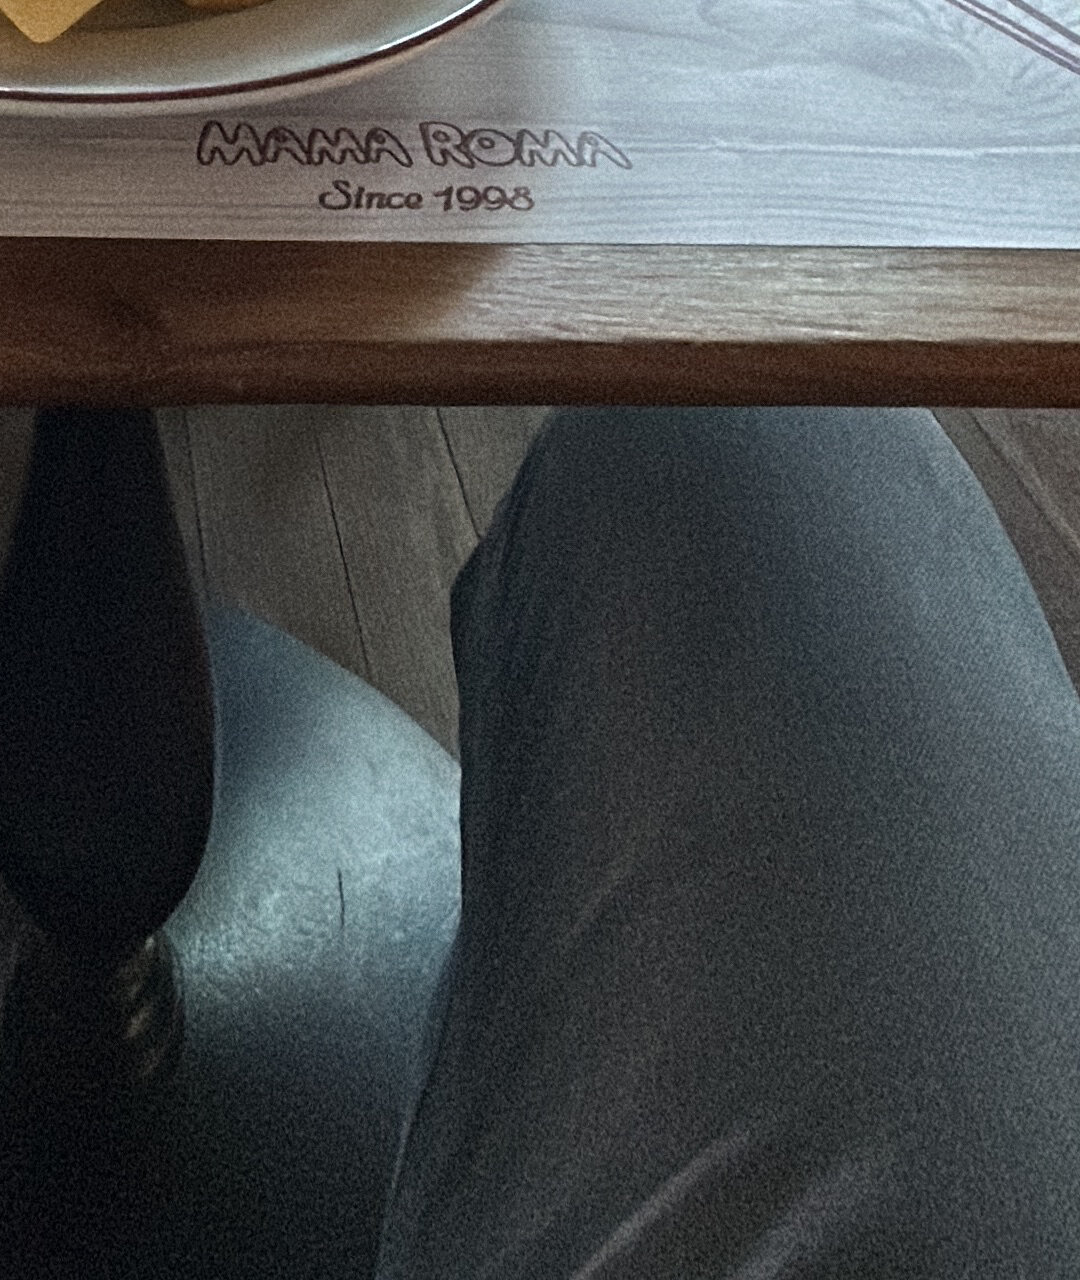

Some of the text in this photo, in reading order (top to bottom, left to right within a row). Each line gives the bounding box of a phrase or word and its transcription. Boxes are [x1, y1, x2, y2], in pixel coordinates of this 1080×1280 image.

[197, 121, 632, 169] MAMA ROMA
[320, 180, 535, 211] Since 1998
